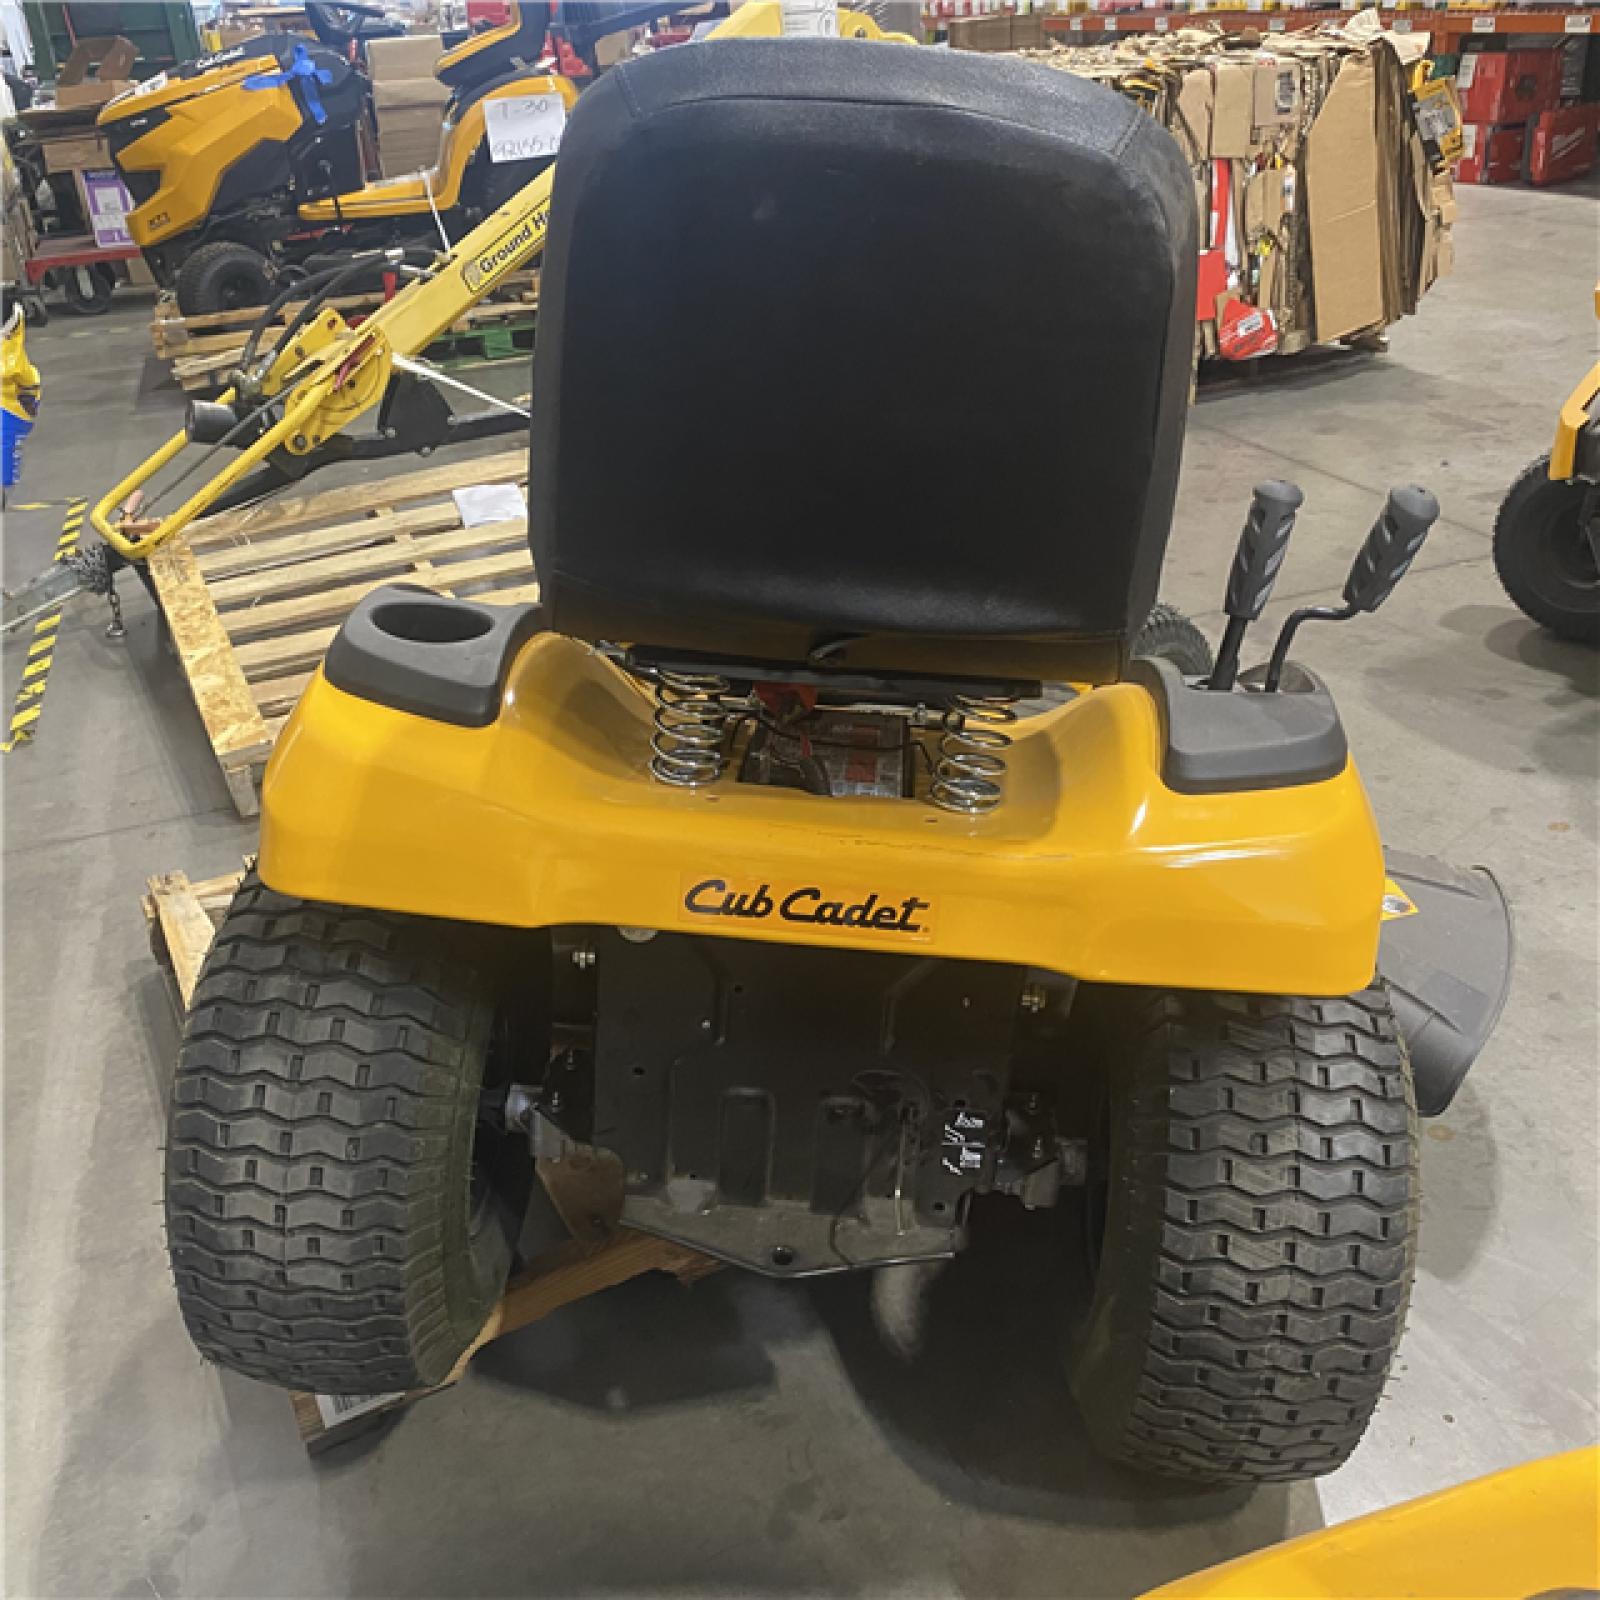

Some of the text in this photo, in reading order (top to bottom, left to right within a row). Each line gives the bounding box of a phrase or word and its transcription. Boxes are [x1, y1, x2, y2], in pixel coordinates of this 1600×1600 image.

[480, 224, 533, 273] Ground
[685, 879, 930, 932] Cub Cadet
